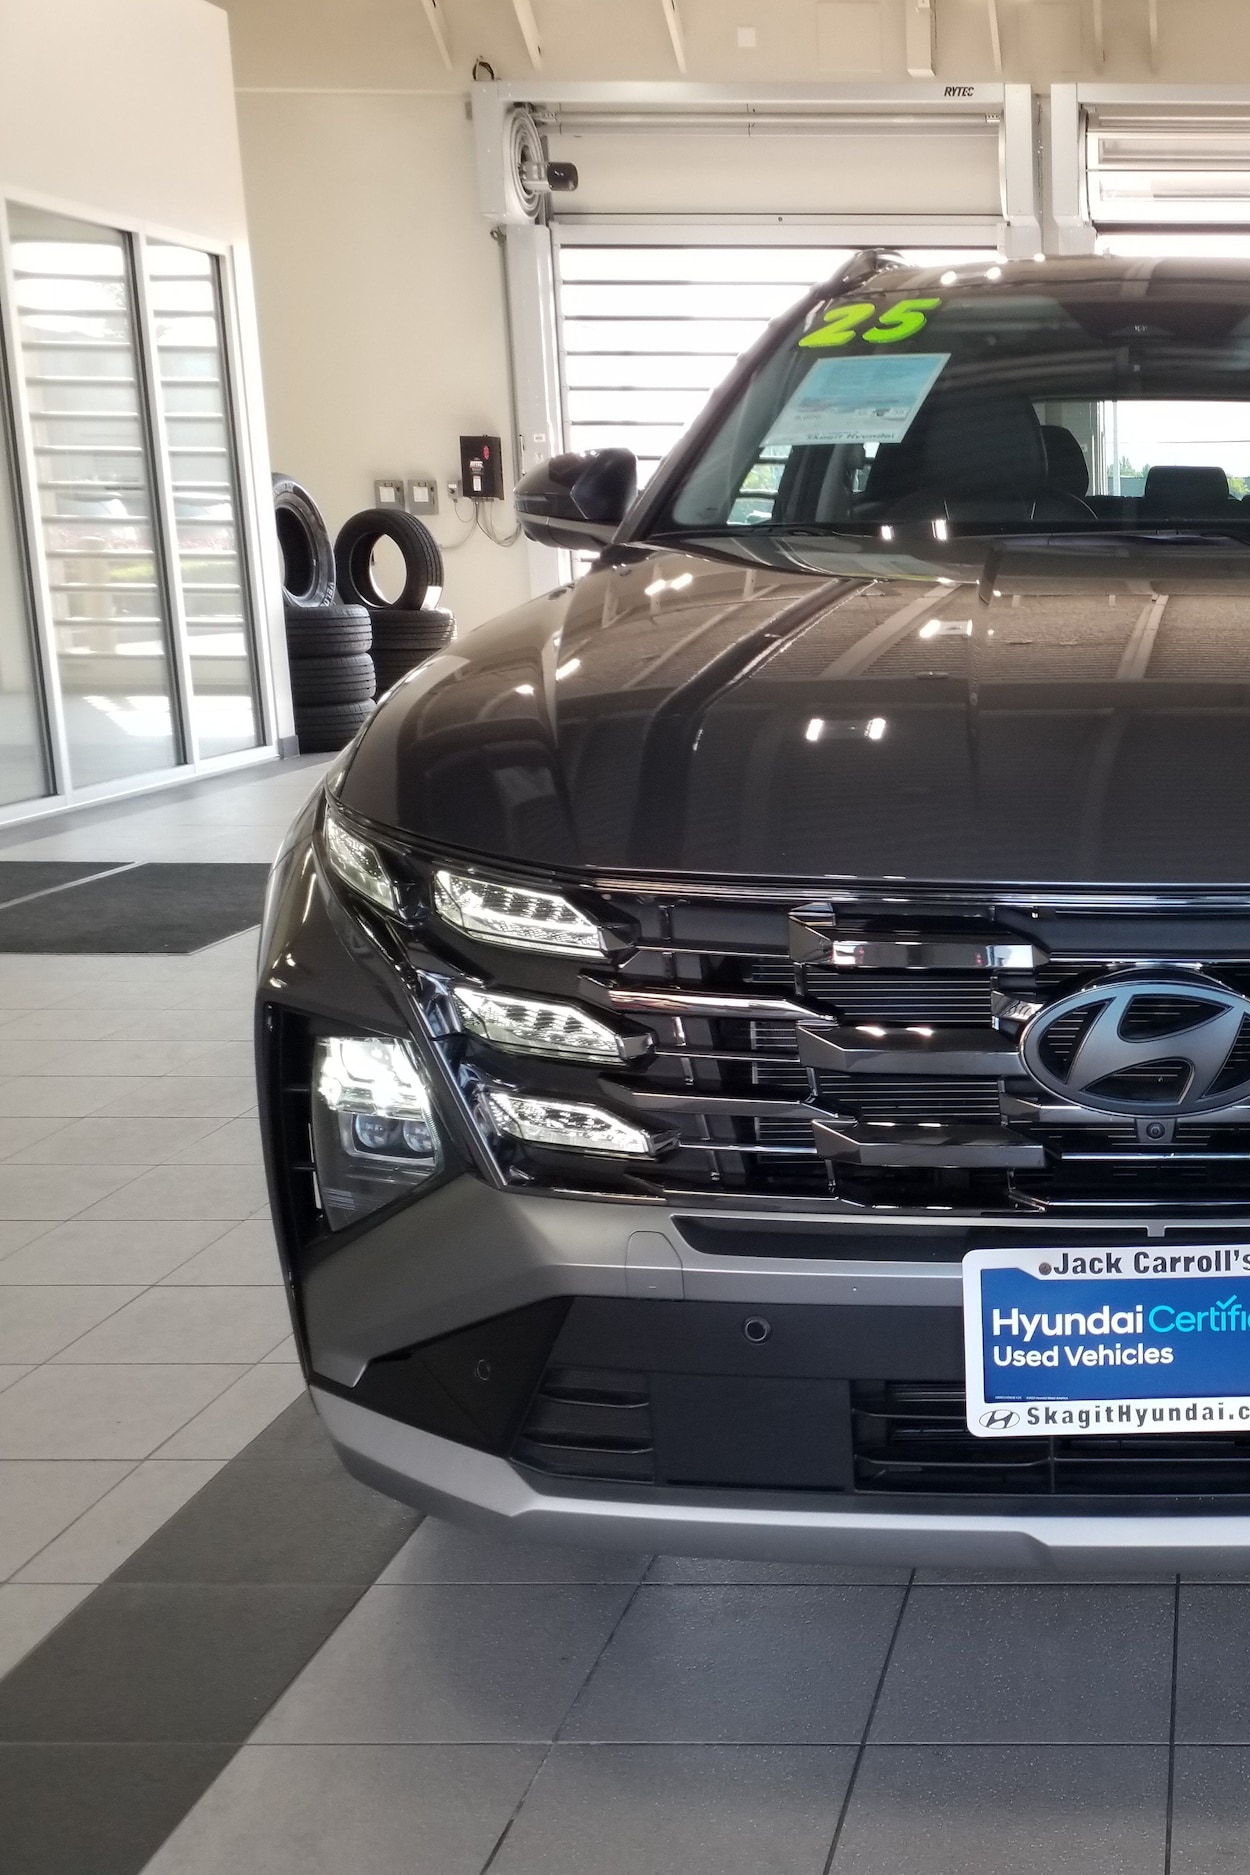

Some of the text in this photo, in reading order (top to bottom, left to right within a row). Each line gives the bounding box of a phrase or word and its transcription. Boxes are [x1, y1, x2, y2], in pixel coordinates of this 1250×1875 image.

[944, 86, 975, 97] RYTEC
[799, 298, 942, 348] 25
[320, 581, 335, 607] VELO
[1053, 1252, 1123, 1276] Jack
[992, 1304, 1144, 1342] Hyundai
[993, 1342, 1174, 1368] Used Vehicles
